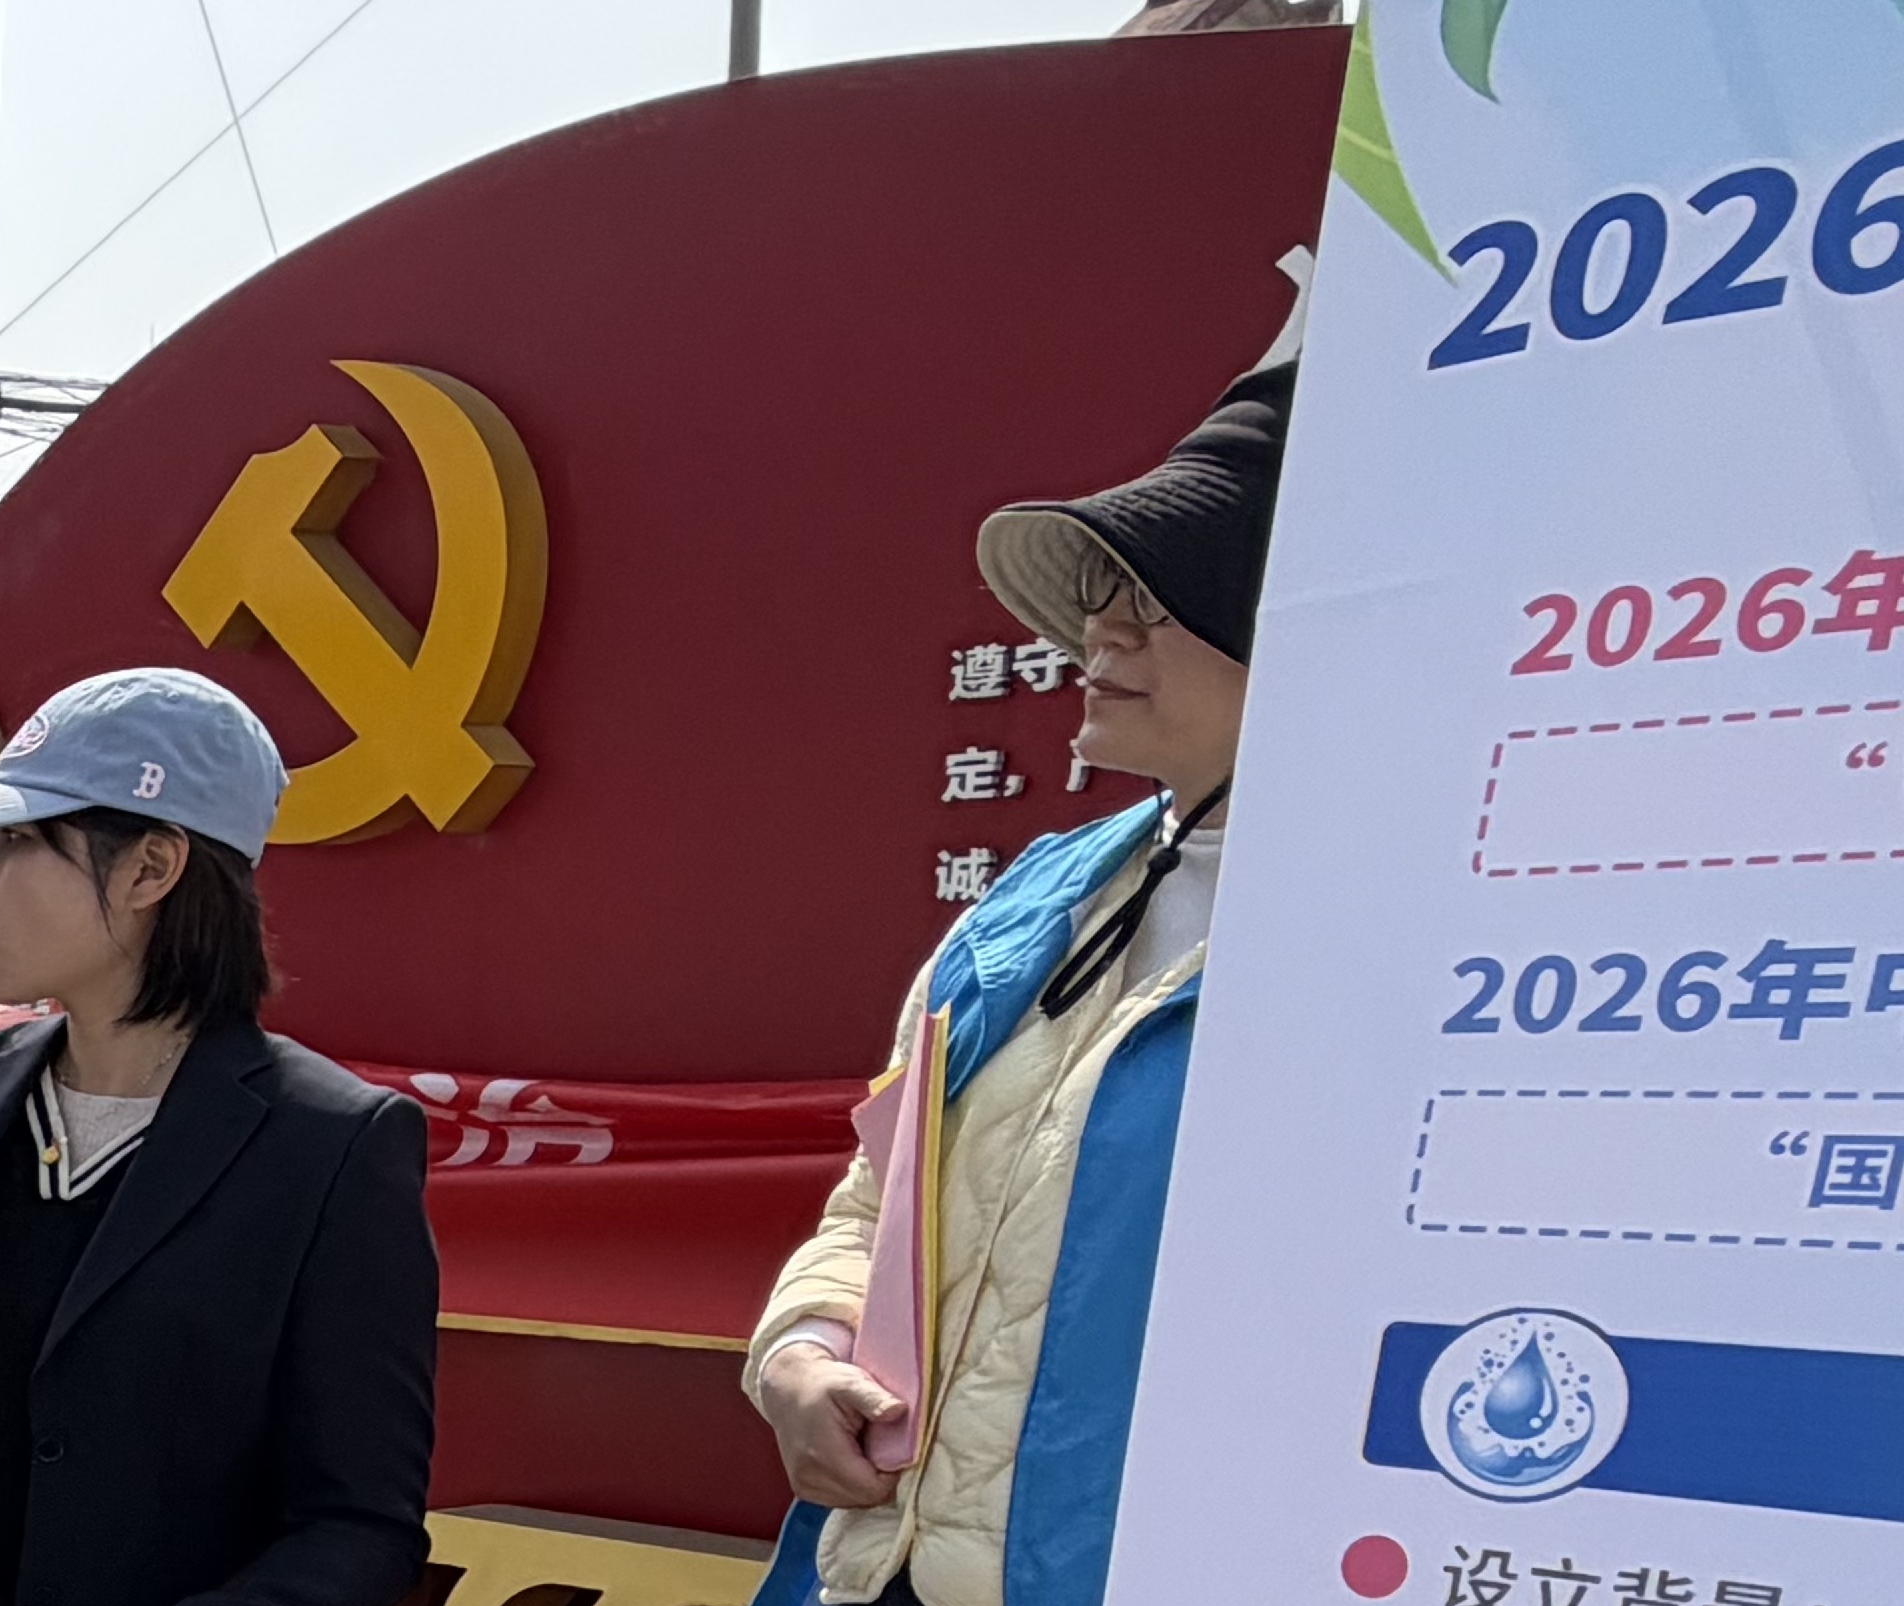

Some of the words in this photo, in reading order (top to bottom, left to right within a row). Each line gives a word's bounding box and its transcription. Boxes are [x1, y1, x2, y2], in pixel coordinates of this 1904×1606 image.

[1427, 139, 1904, 370] 2026
[1510, 549, 1904, 675] 2026年
[949, 638, 1092, 700] 遵守
[132, 761, 166, 799] B
